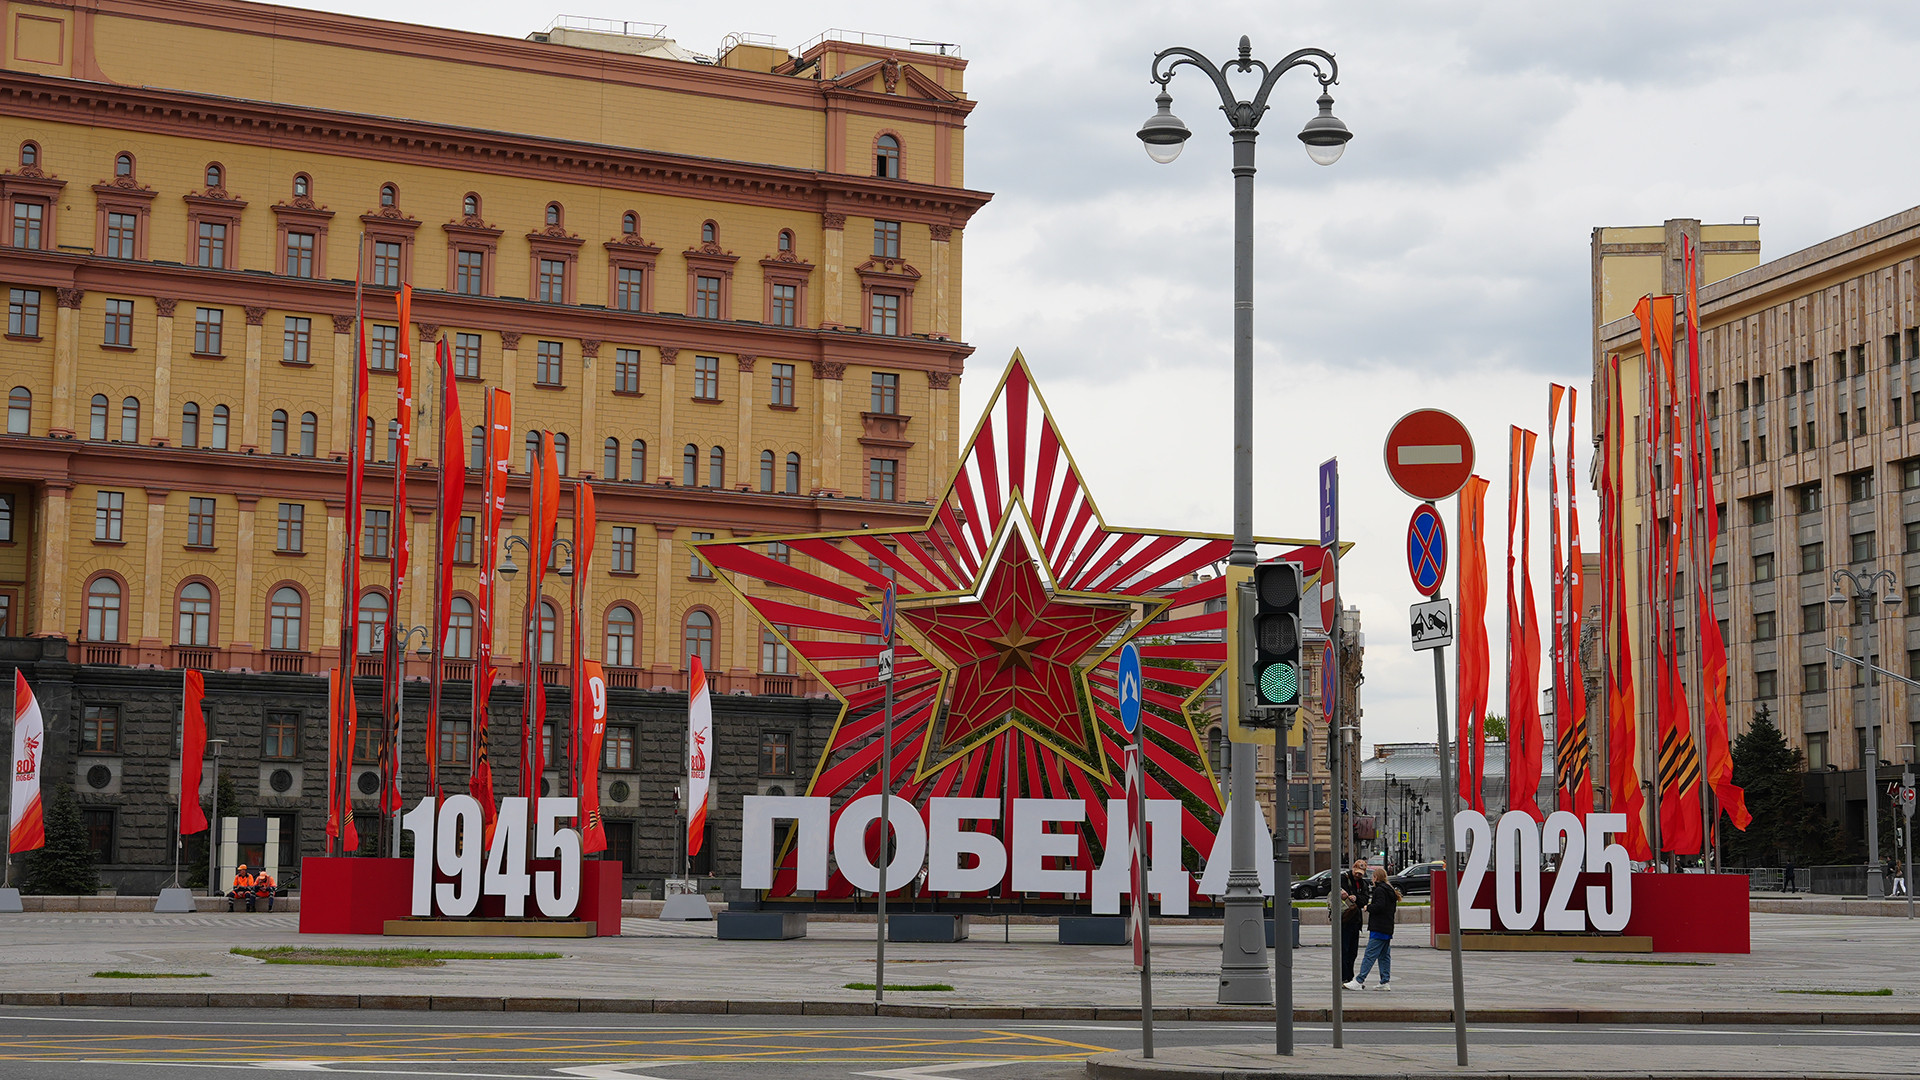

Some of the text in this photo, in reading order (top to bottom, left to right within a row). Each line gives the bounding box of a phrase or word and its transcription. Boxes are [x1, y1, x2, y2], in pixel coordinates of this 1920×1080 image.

[589, 676, 605, 720] 9
[16, 759, 29, 773] 80
[403, 794, 583, 918] 1945
[741, 794, 1275, 916] ПОБЕДА
[1453, 809, 1633, 932] 2025
